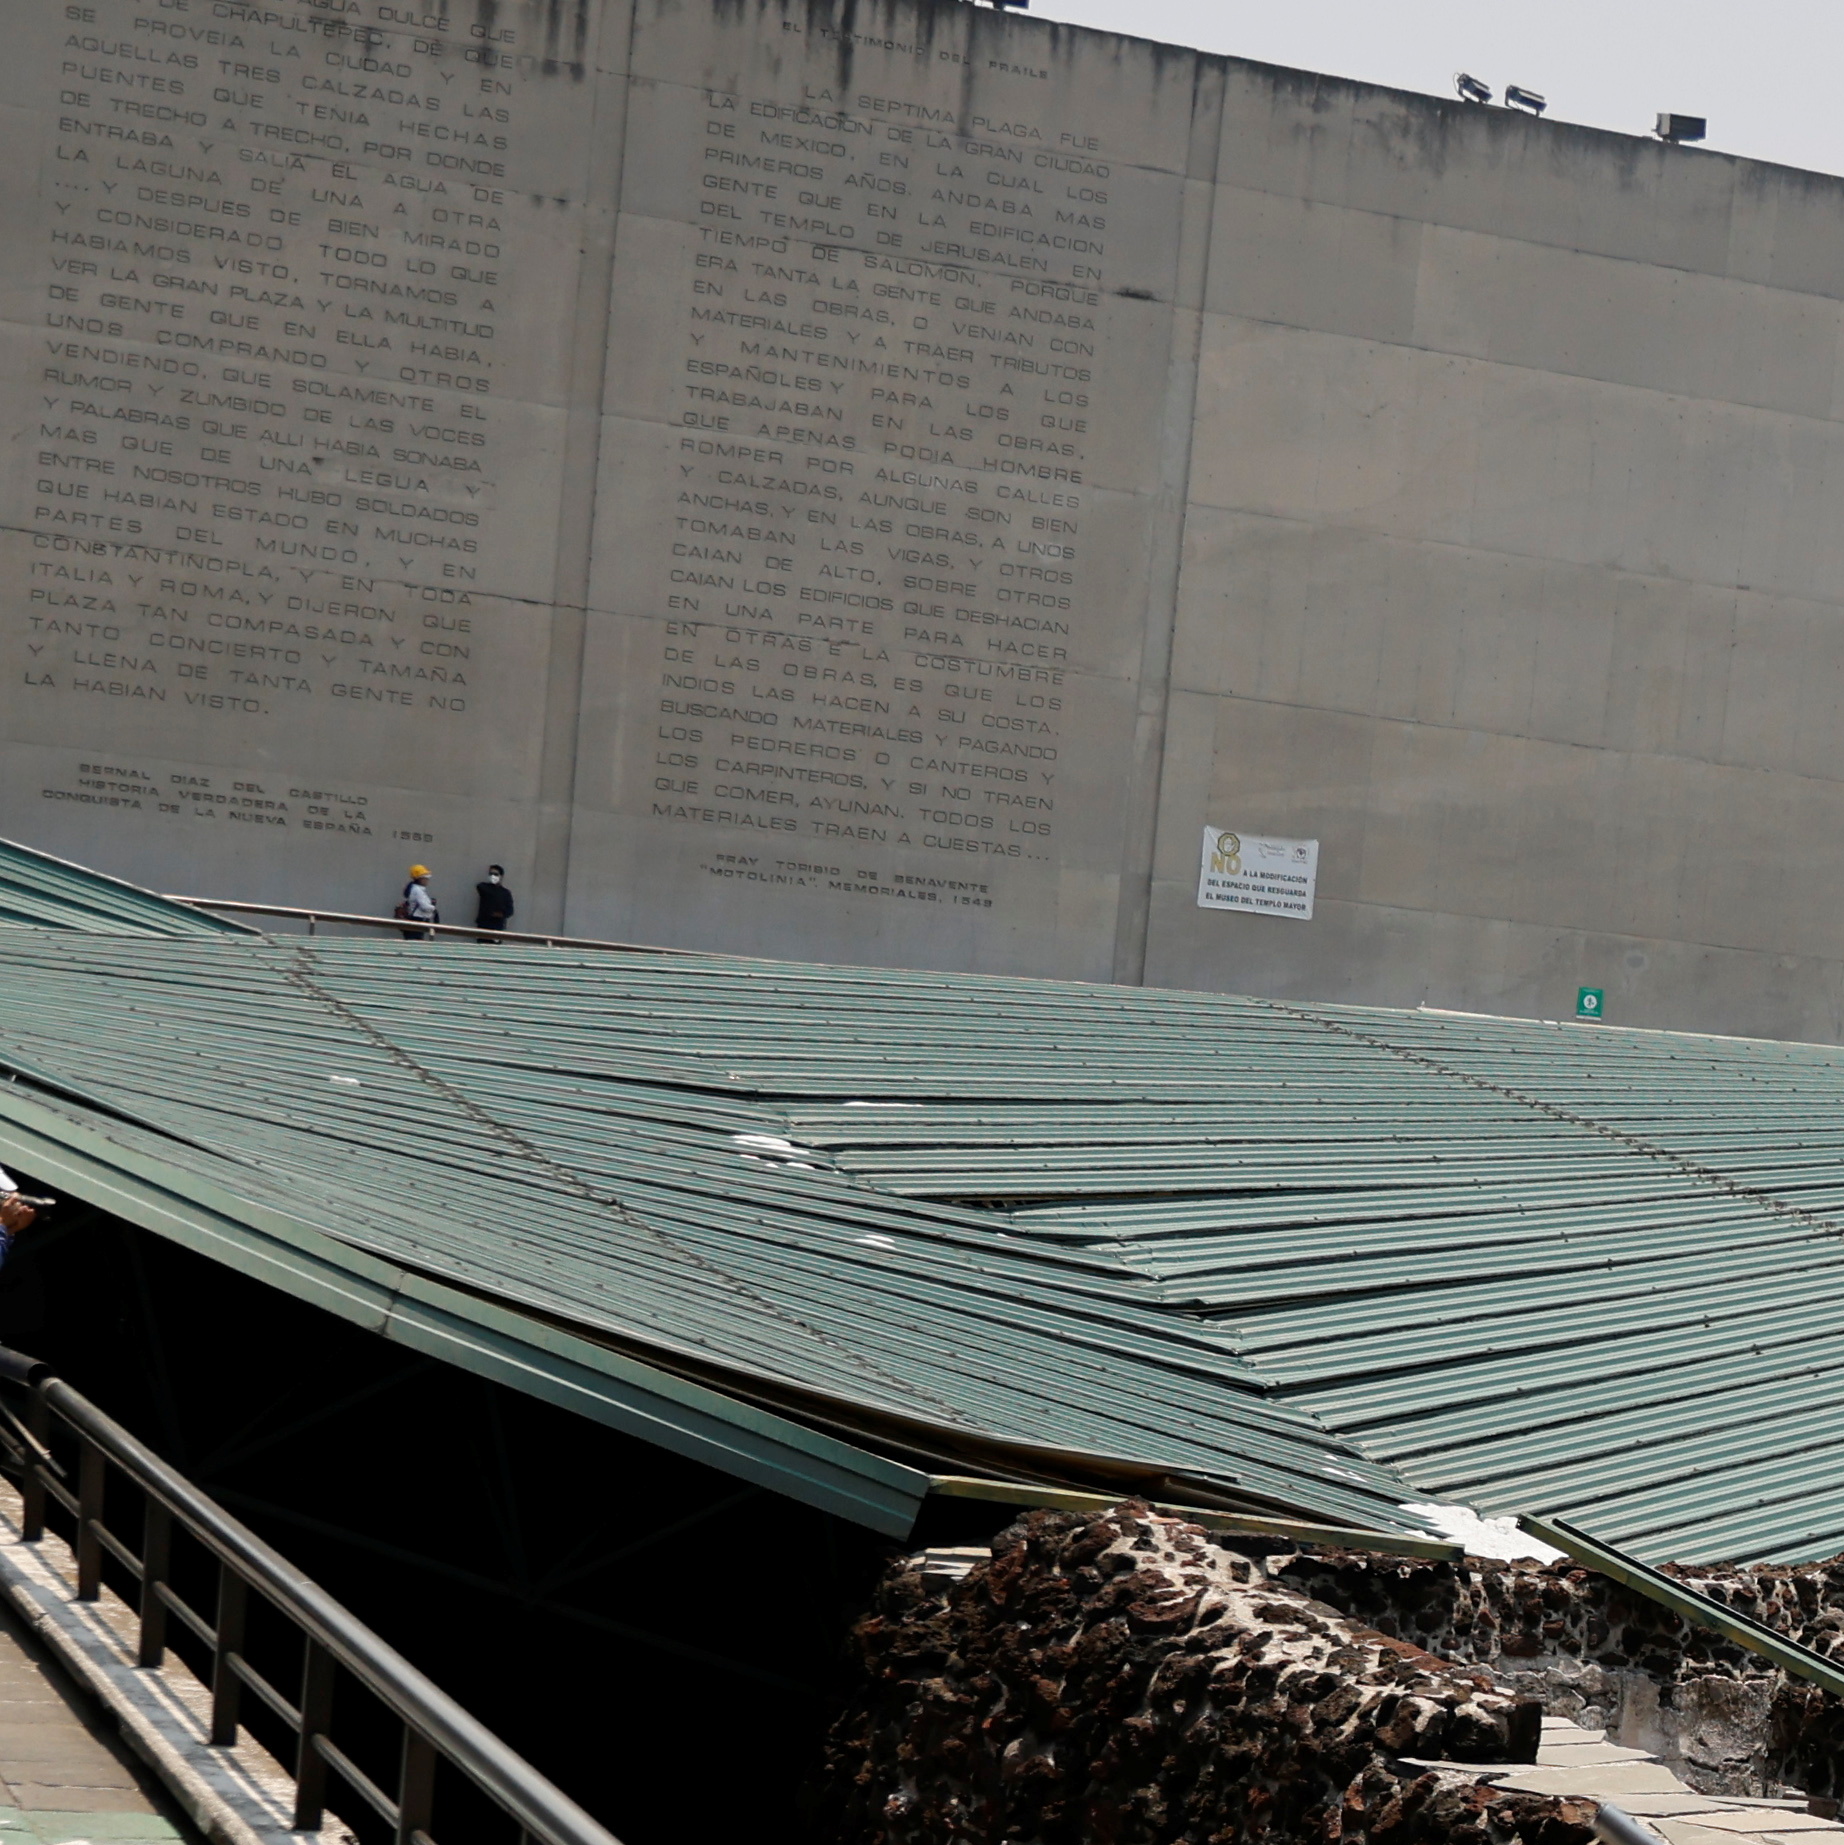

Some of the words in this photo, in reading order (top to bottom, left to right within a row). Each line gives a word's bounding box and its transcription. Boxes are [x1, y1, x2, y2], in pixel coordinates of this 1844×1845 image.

[64, 35, 199, 70] AQUELLAS
[218, 59, 281, 84] TRES
[301, 74, 441, 111] CALZADAS
[462, 103, 510, 122] LAS
[782, 21, 801, 33] EL
[939, 50, 971, 65] DEL
[989, 60, 1049, 80] FRAILE
[804, 85, 833, 103] LA
[858, 94, 956, 126] SEPTIMA
[972, 114, 1043, 142] PLAGA
[1059, 132, 1100, 152] FUE
[55, 146, 90, 163] LA
[115, 155, 223, 186] LAGUNA
[250, 177, 285, 196] DE
[311, 187, 364, 209] UNA
[392, 201, 408, 216] A
[431, 207, 501, 230] OTRA
[702, 173, 778, 200] GENTE
[797, 191, 843, 211] QUE
[866, 202, 897, 221] EN
[917, 212, 947, 229] LA
[969, 220, 1104, 256] EDIFICACION
[54, 202, 71, 215] Y
[96, 209, 283, 251] CONSIDERADO
[317, 243, 388, 268] TODO
[405, 258, 437, 275] LO
[450, 265, 498, 285] QUE
[51, 257, 98, 277] VER
[110, 266, 140, 285] LA
[151, 273, 219, 296] GRAN
[229, 284, 305, 310] PLAZA
[316, 298, 333, 313] Y
[343, 303, 374, 321] LA
[383, 308, 495, 338] MULTITUD
[695, 252, 739, 273] ERA
[751, 262, 821, 286] TANTA
[831, 276, 860, 293] LA
[872, 282, 941, 307] GENTE
[954, 296, 997, 316] QUE
[1007, 305, 1095, 332] ANDABA
[45, 313, 124, 337] UNOS
[154, 329, 328, 368] COMPRANDO
[354, 359, 370, 374] Y
[399, 366, 491, 392] OTROS
[689, 332, 705, 347] Y
[739, 340, 970, 390] MANTENIMIENTOS
[999, 382, 1015, 397] A
[1043, 389, 1089, 408] LOS
[690, 305, 829, 341] MATERIALES
[846, 330, 861, 345] Y
[872, 336, 887, 350] A
[903, 339, 974, 364] TRAER
[989, 353, 1092, 383] TRIBUTOS
[42, 369, 133, 393] RUMOR
[147, 383, 165, 397] Y
[179, 388, 287, 418] ZUMBIDO
[302, 407, 333, 425] DE
[348, 415, 395, 433] LAS
[409, 423, 486, 446] VOCES
[37, 451, 116, 476] ENTRE
[133, 464, 262, 496] NOSOTROS
[277, 486, 342, 507] HUBO
[355, 496, 480, 526] SOLDADOS
[679, 437, 784, 465] ROMPER
[805, 456, 855, 476] POR
[874, 467, 978, 495] ALGUNAS
[995, 485, 1080, 509] CALLES
[36, 479, 90, 500] QUE
[103, 488, 198, 515] HABIAN
[211, 503, 309, 530] ESTADO
[324, 519, 359, 537] EN
[373, 526, 478, 553] MUCHAS
[29, 588, 117, 613] PLAZA
[135, 603, 189, 623] TAN
[206, 612, 375, 647] COMPASADA
[390, 635, 406, 650] Y
[419, 640, 471, 659] CON
[667, 595, 700, 612] EN
[724, 602, 773, 622] UNA
[797, 612, 874, 635] PARTE
[903, 626, 964, 647] PARA
[986, 638, 1068, 661] HACER
[669, 569, 735, 590] CAIAN
[742, 579, 789, 597] LOS
[799, 586, 894, 612] EDIFICIOS
[902, 600, 946, 619] QUE
[954, 607, 1070, 635] DESHACIAN
[23, 671, 56, 688] LA
[72, 677, 166, 702] HABIAN
[27, 643, 45, 657] Y
[73, 650, 158, 674] LLENA
[177, 662, 209, 680] DE
[229, 669, 312, 693] TANTA
[329, 683, 414, 706] GENTE
[428, 695, 466, 712] NO
[659, 699, 779, 727] BUSCANDO
[792, 715, 924, 745] MATERIALES
[935, 733, 948, 747] Y
[958, 736, 1058, 760] PAGANDO
[41, 788, 143, 810] CONQUISTA
[157, 802, 181, 815] DE
[193, 807, 217, 819] LA
[227, 810, 289, 827] NUEVA
[302, 819, 373, 837] ESPAÑA
[77, 778, 160, 797] HISTORIA
[177, 790, 289, 812] VERDADERA
[306, 804, 330, 817] DE
[343, 809, 367, 821] LA
[78, 762, 151, 781] BERNAL
[169, 774, 211, 788] DIAZ
[232, 781, 266, 795] DEL
[287, 787, 369, 806] CASTILLO
[651, 803, 798, 832] MATERIALES
[810, 820, 887, 842] TRAEN
[896, 831, 912, 846] A
[715, 853, 759, 866] FRAY
[775, 860, 841, 876] TORIBIO
[856, 869, 878, 881] DE
[892, 874, 989, 894] BENAVENTE
[1207, 878, 1220, 887] DEL
[1222, 881, 1250, 891] ESPACIO
[1251, 884, 1265, 893] QUE
[1267, 886, 1307, 898] RESGUARDA
[1210, 852, 1242, 875] NO
[1243, 869, 1248, 877] A
[1249, 870, 1258, 878] LA
[1205, 892, 1214, 900] EL
[1215, 893, 1239, 903] MUSEO
[1240, 896, 1253, 905] DEL
[1256, 898, 1282, 908] TEMPLO
[1283, 901, 1307, 911] MAYOR
